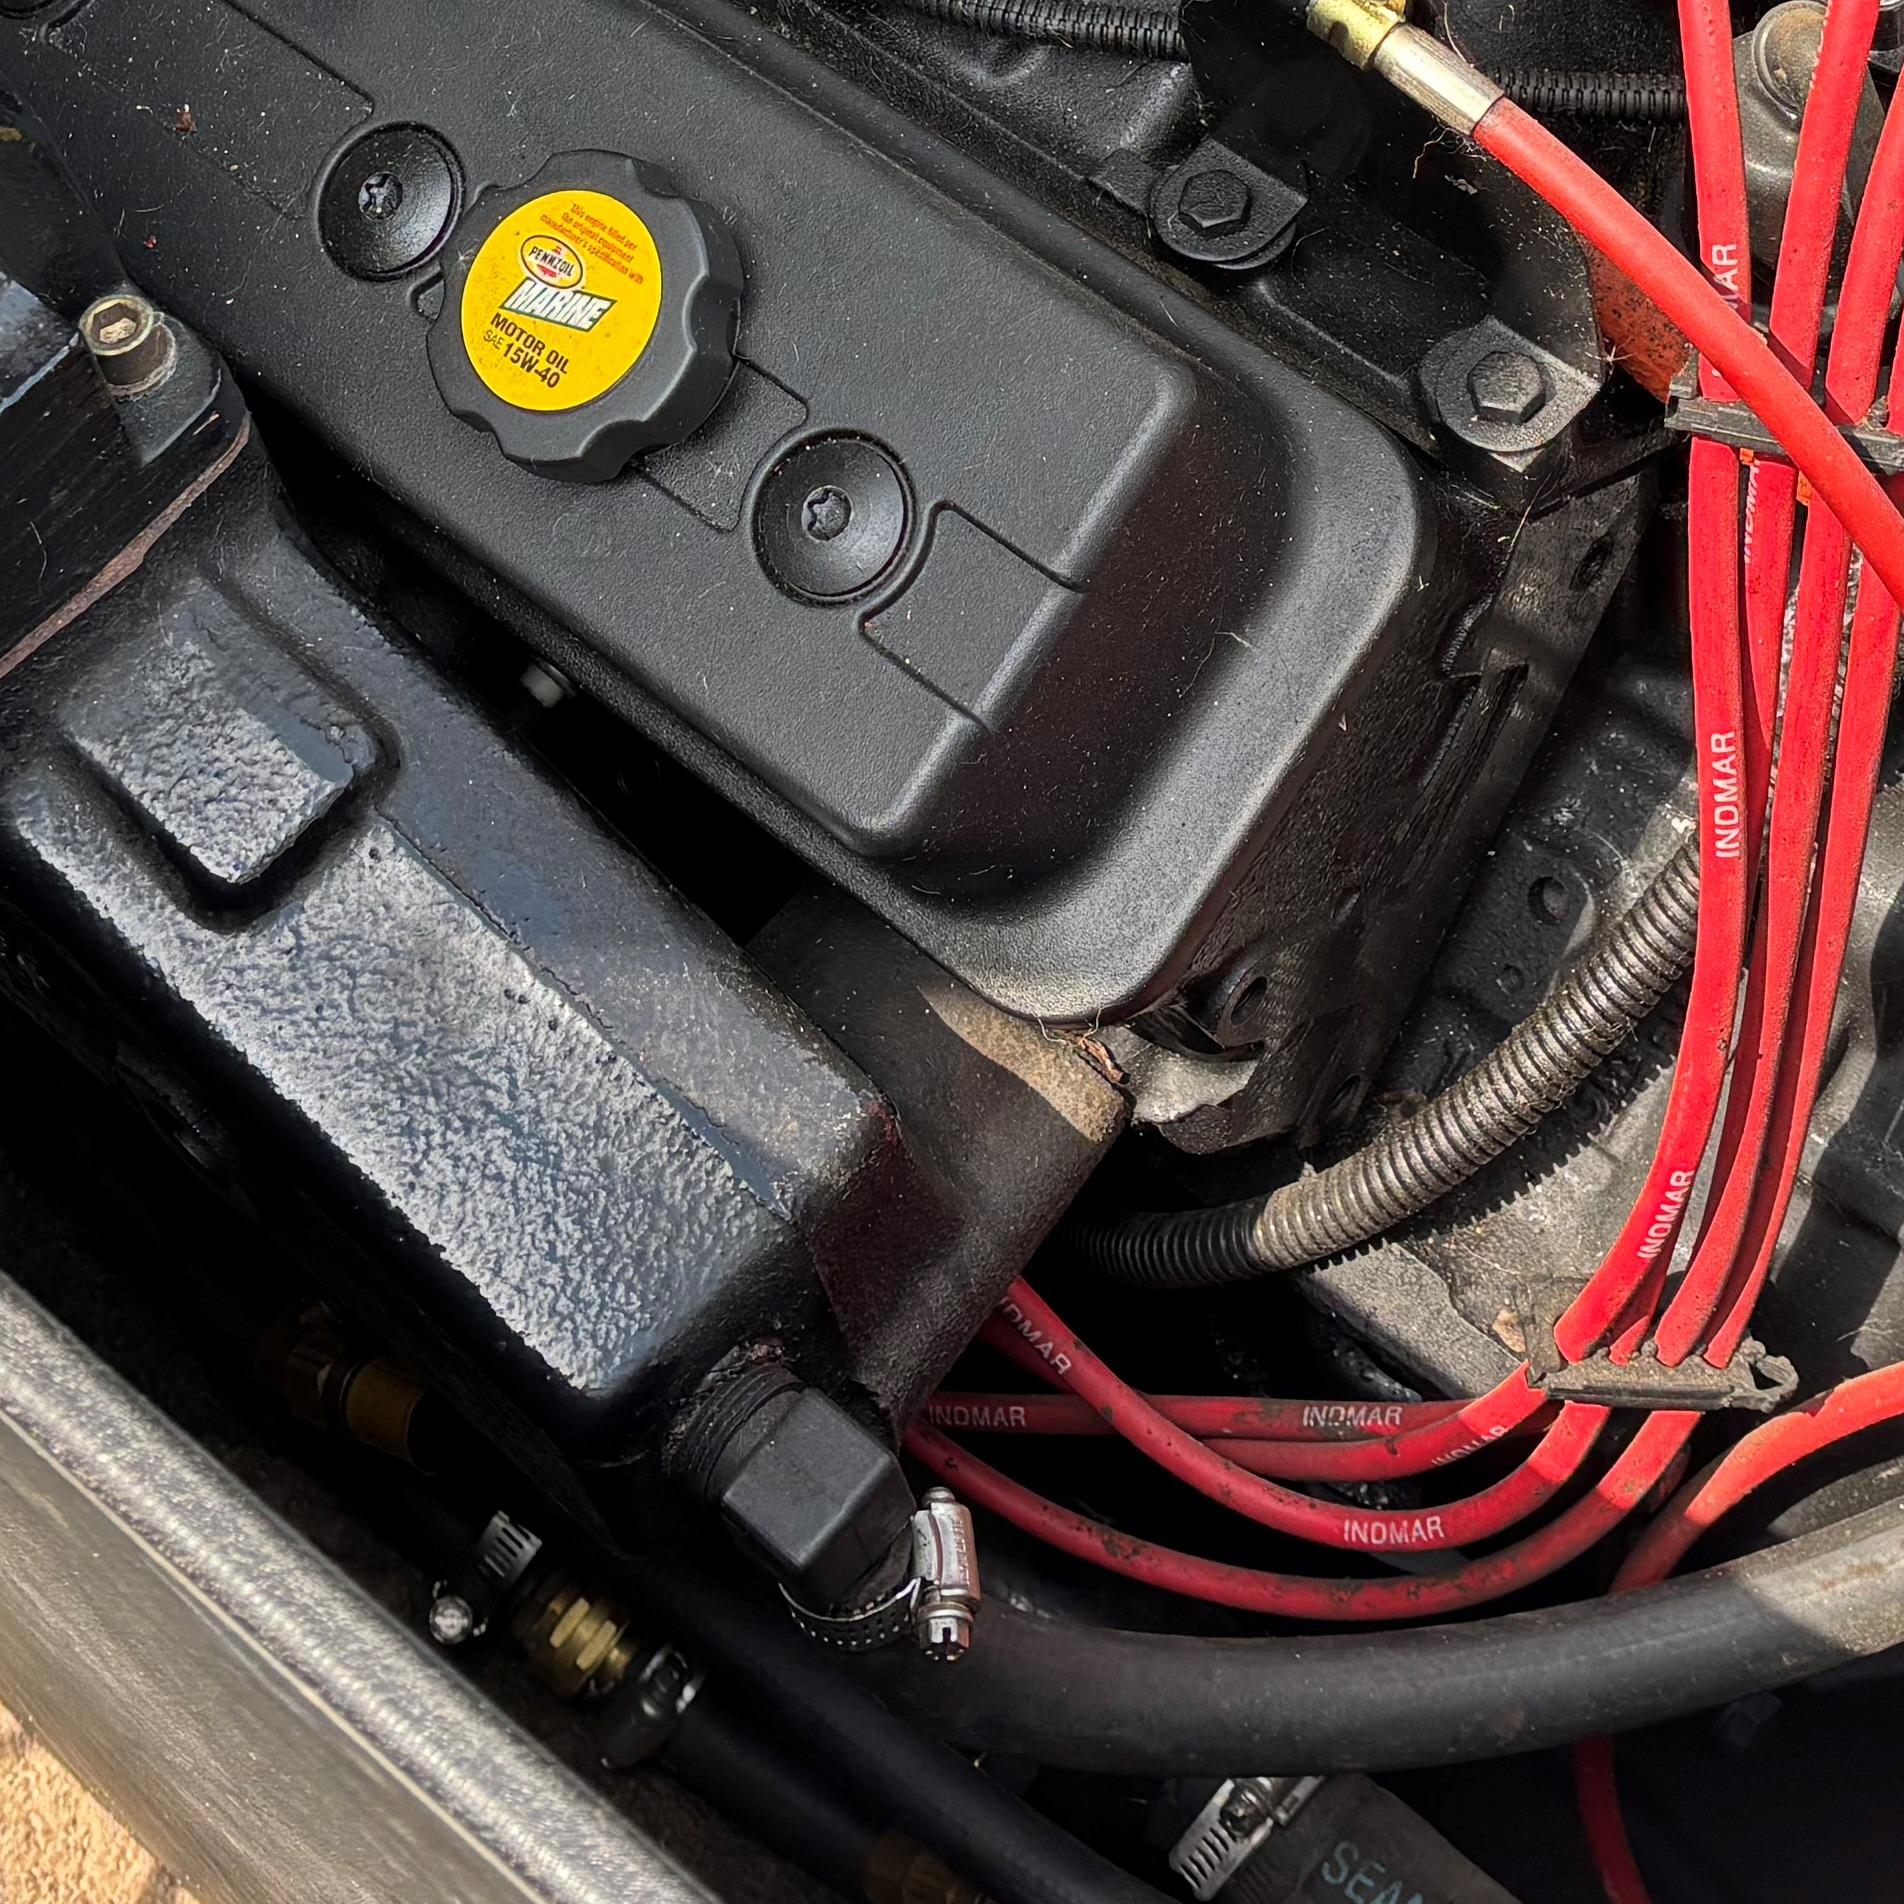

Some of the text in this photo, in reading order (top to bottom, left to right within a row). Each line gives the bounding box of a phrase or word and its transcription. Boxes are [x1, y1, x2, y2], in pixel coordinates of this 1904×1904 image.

[528, 246, 575, 277] PENNZOIL
[501, 277, 615, 330] MARINE
[483, 329, 561, 388] SAE 15W-40
[490, 312, 569, 375] MOTOR OIL
[1710, 731, 1740, 858] INDMAR
[1637, 1170, 1696, 1259] INDMAR
[928, 1405, 1026, 1427] INDMAR
[1302, 1405, 1403, 1427] INDMAR
[1344, 1515, 1445, 1545] INDMAR
